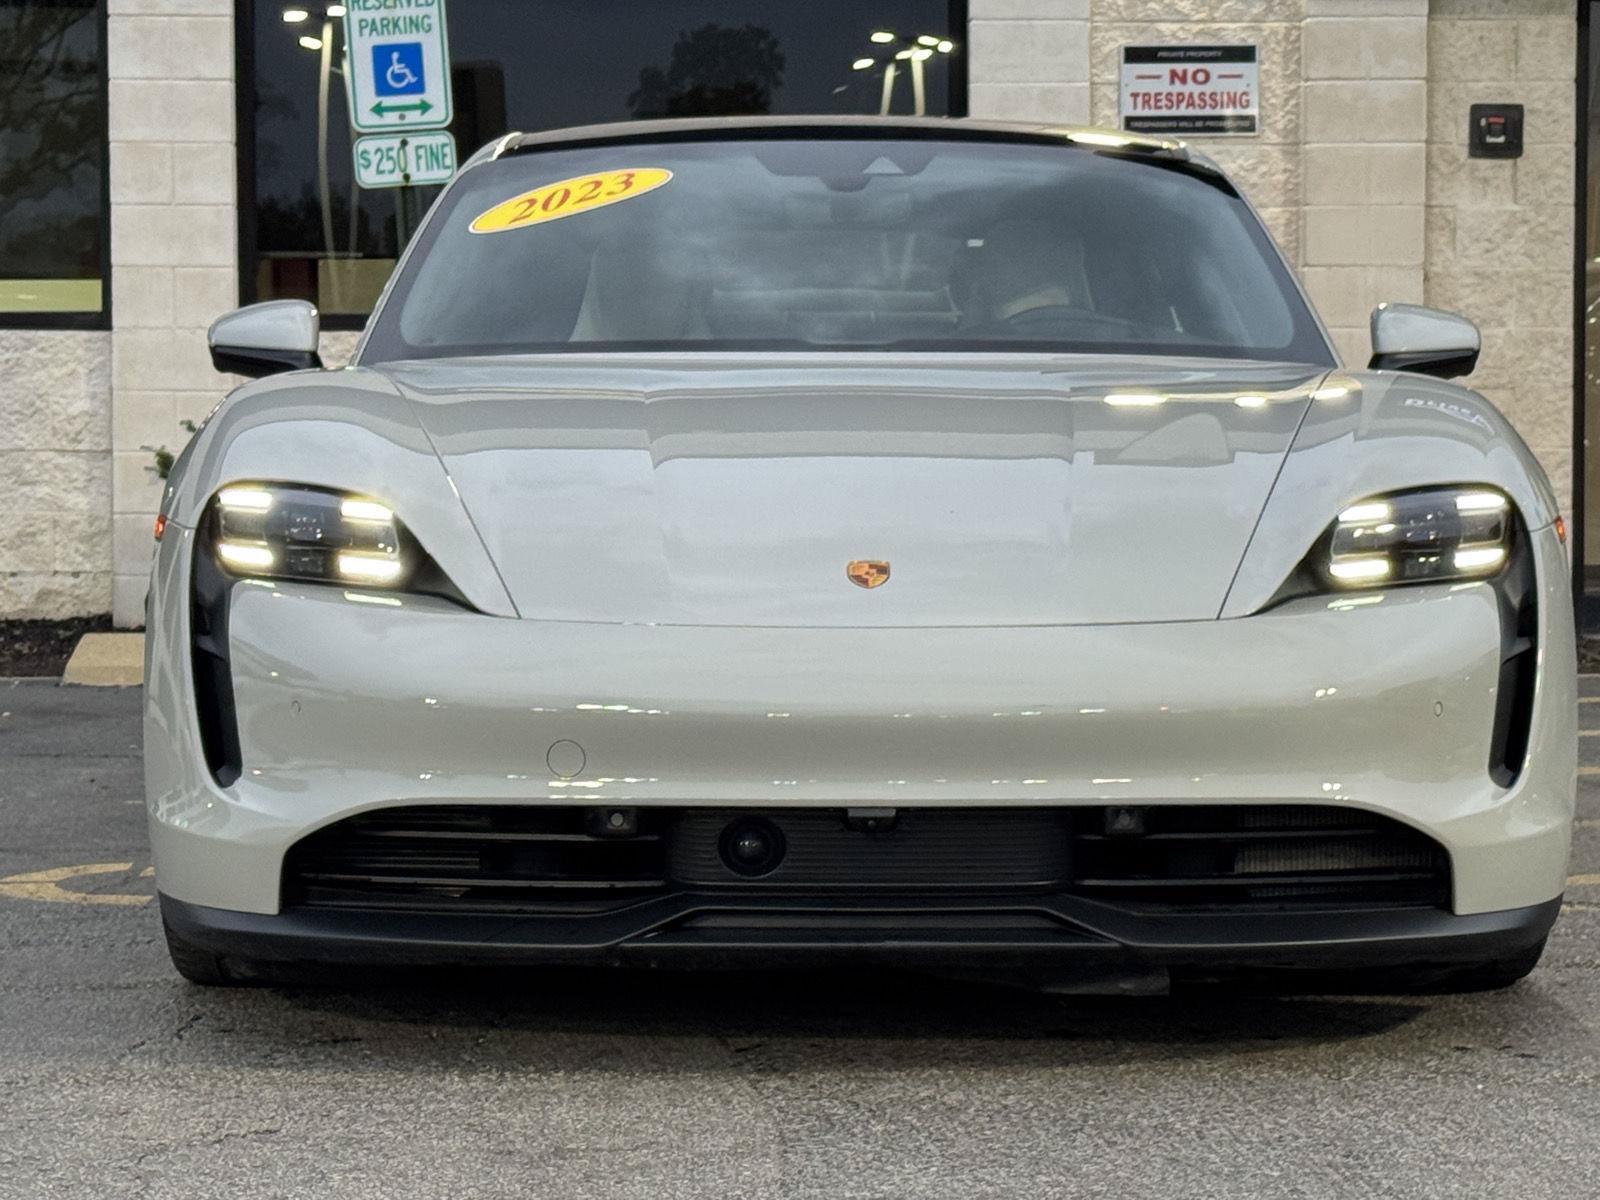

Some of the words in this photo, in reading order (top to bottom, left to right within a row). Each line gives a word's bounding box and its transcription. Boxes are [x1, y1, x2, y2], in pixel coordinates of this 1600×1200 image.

[358, 15, 432, 37] PARKING
[1169, 68, 1211, 86] NO
[1130, 91, 1250, 110] TRESPASSING
[414, 143, 451, 172] FINE
[509, 173, 635, 224] 2023
